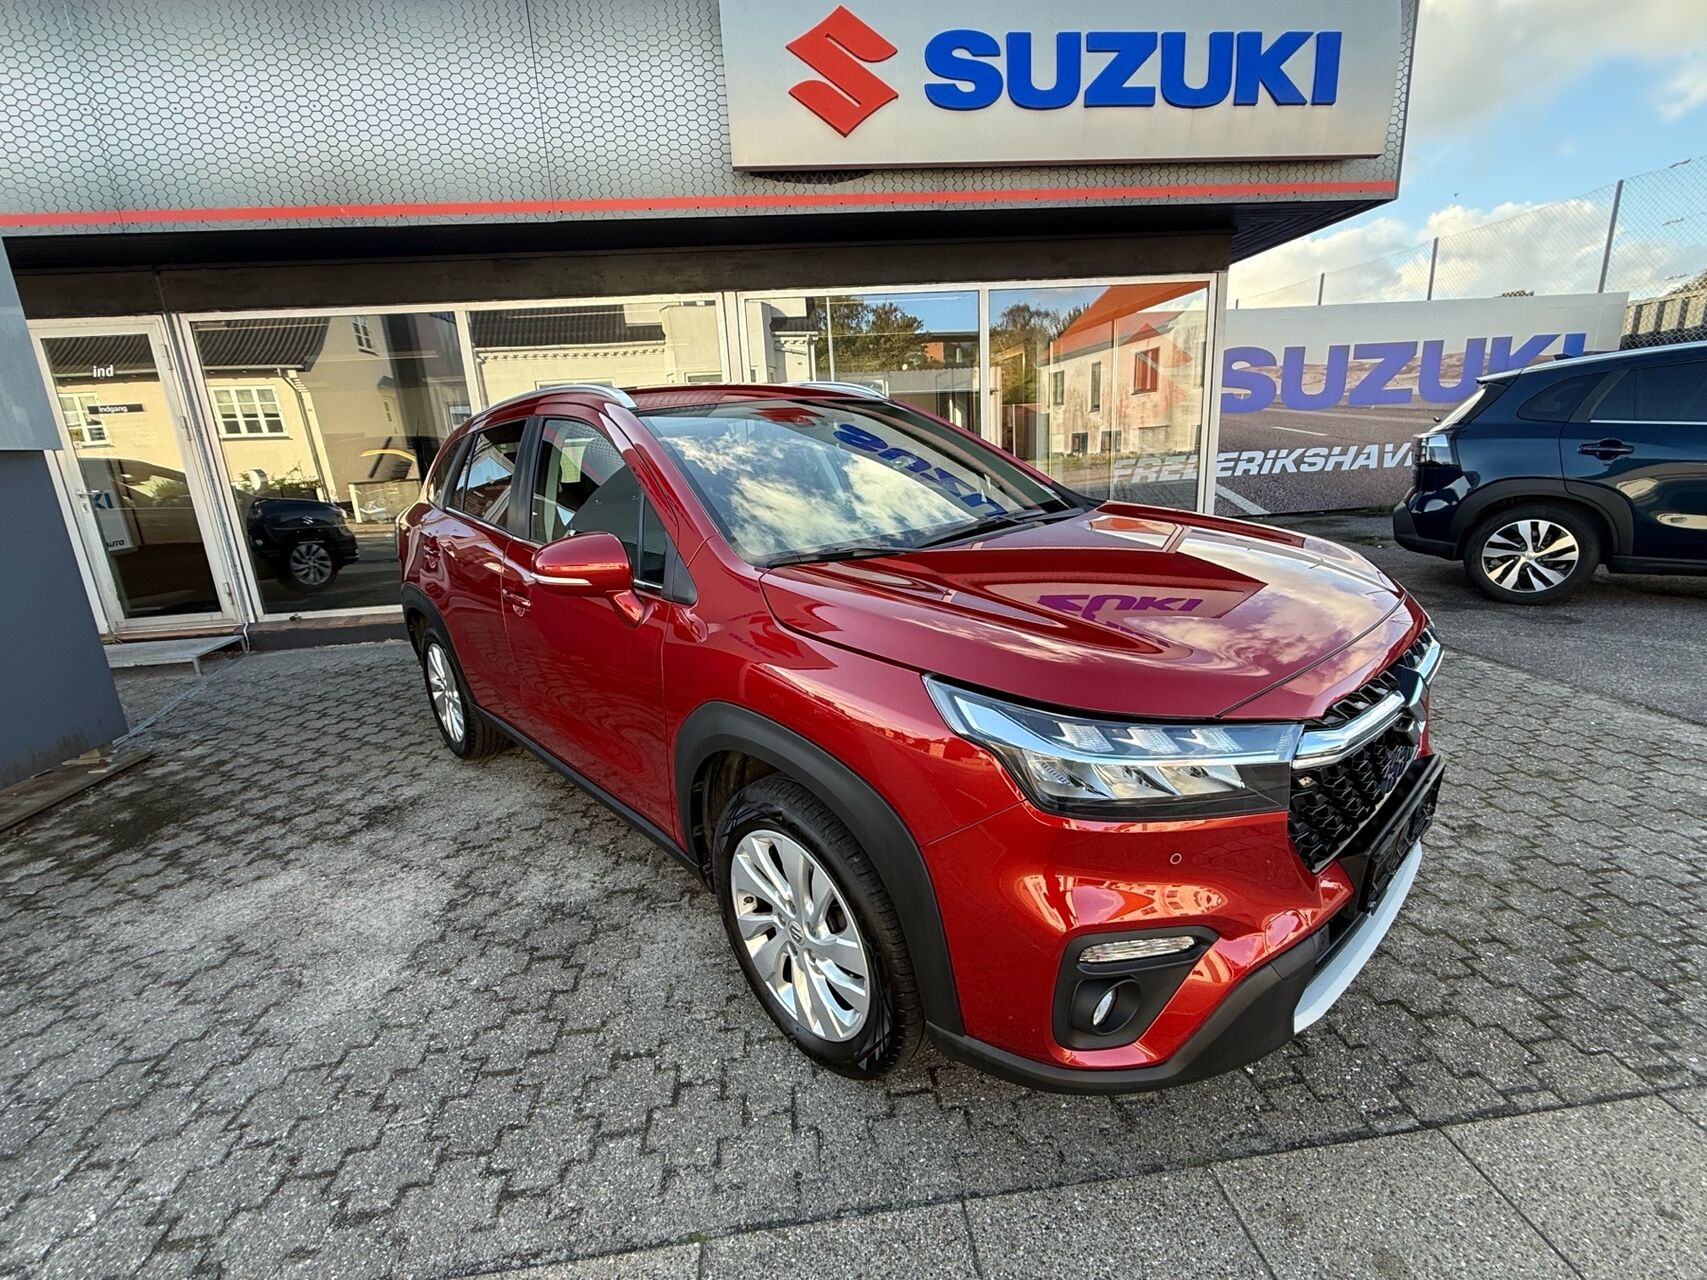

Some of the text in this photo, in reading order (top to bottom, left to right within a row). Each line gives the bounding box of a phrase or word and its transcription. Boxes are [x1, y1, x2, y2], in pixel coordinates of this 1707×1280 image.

[924, 29, 1342, 111] SUZUKI
[93, 364, 114, 378] ind
[1112, 442, 1413, 483] FREERIKSHAV
